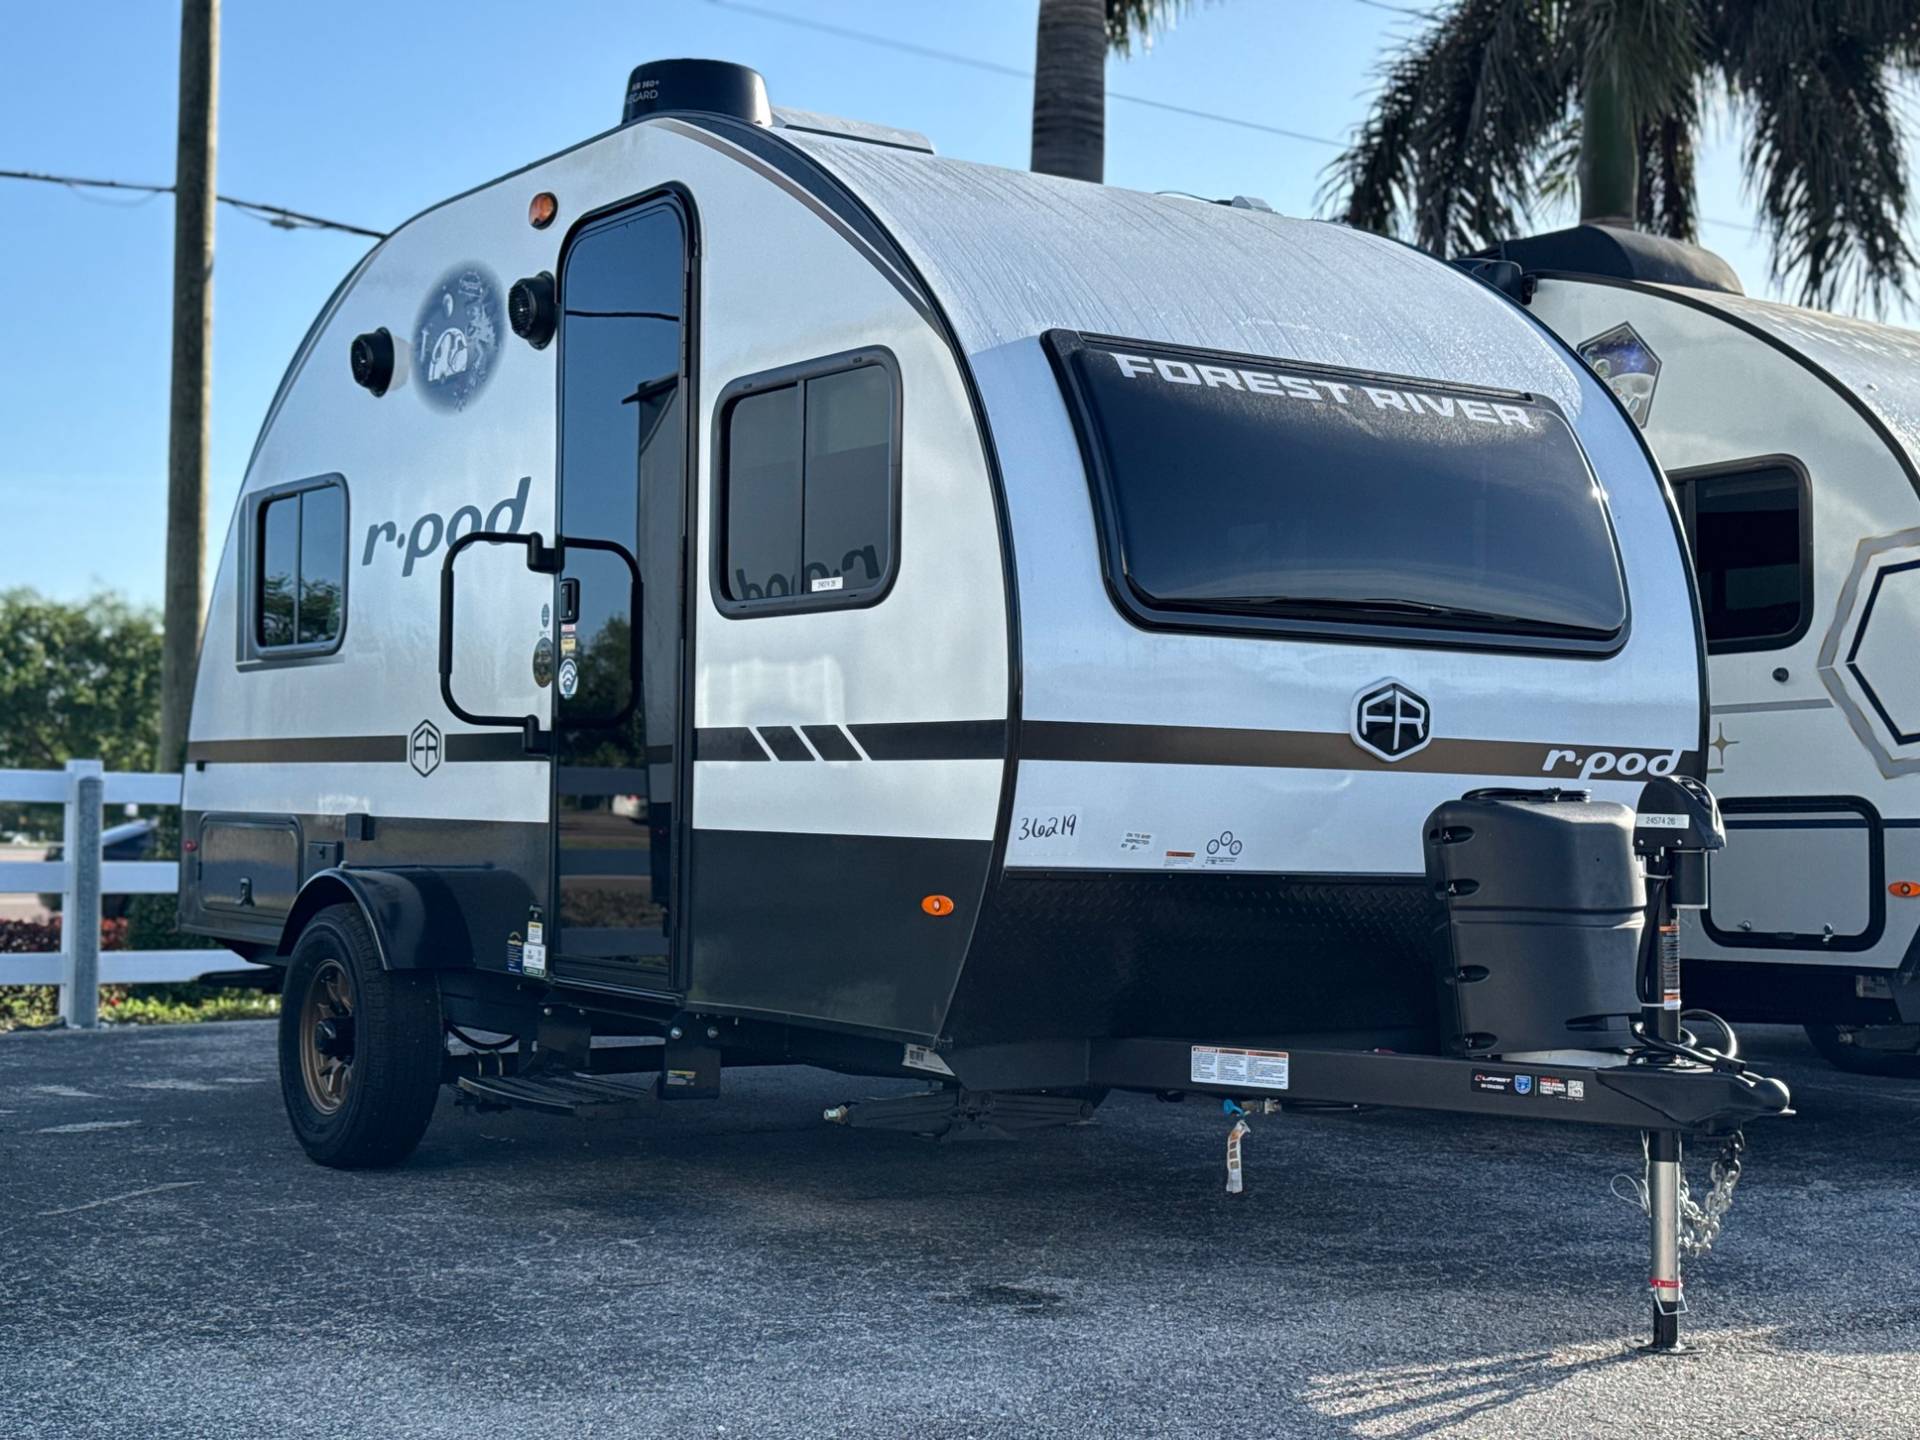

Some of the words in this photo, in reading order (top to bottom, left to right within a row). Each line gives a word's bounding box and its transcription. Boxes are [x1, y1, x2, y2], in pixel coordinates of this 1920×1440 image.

[1109, 352, 1351, 404] FOREST
[1360, 386, 1535, 429] RIVER
[1018, 814, 1077, 841] 36219
